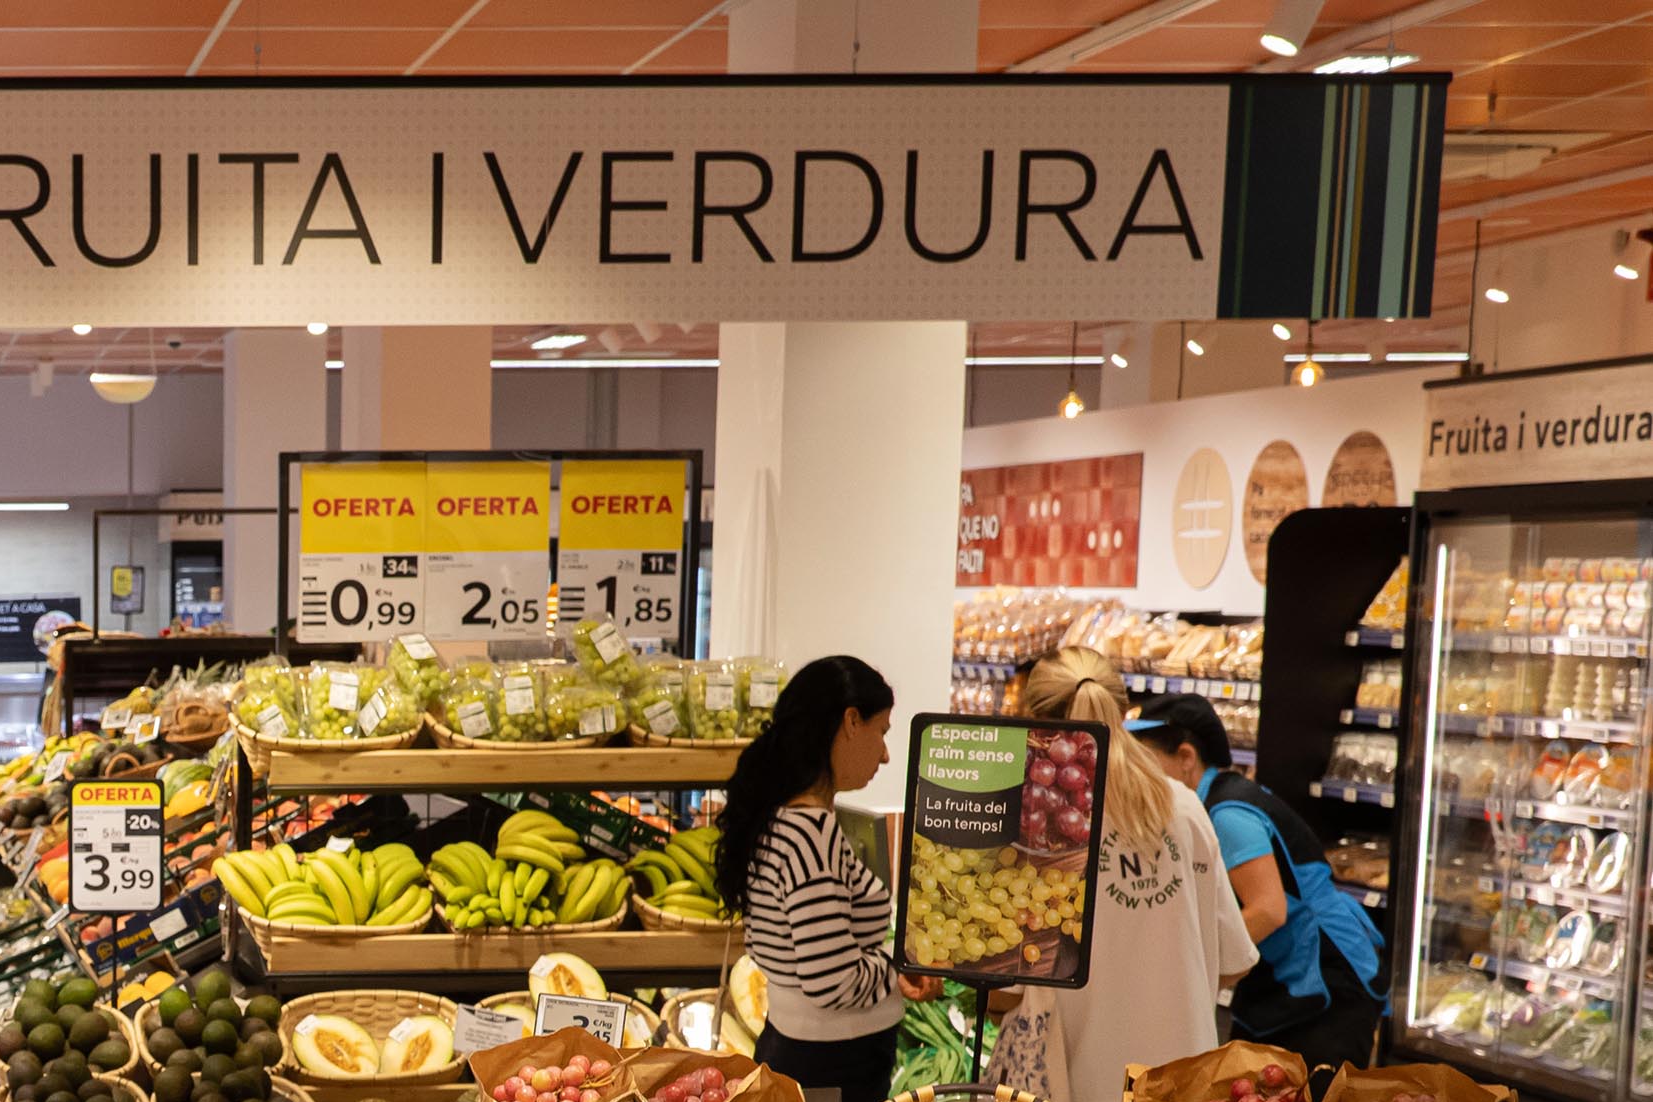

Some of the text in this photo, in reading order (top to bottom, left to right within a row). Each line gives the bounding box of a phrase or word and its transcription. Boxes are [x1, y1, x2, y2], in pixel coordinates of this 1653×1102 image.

[430, 152, 445, 265] I
[483, 148, 1205, 266] VERDURA
[1428, 404, 1653, 457] Fruita i verdura
[313, 498, 415, 517] OFERTA
[437, 497, 539, 515] OFERTA
[571, 495, 673, 514] OFERTA
[982, 513, 1000, 540] NO
[931, 724, 999, 743] Especial
[929, 745, 1015, 763] raïm sense
[927, 764, 980, 781] llavors
[80, 788, 153, 801] OFERTA
[926, 797, 1007, 815] La fruita del
[924, 815, 1003, 835] bon temps!
[1099, 828, 1120, 873] FIFTH
[83, 854, 155, 894] 3,99
[1106, 875, 1183, 910] NEW YORK
[593, 1019, 613, 1030] €/kg
